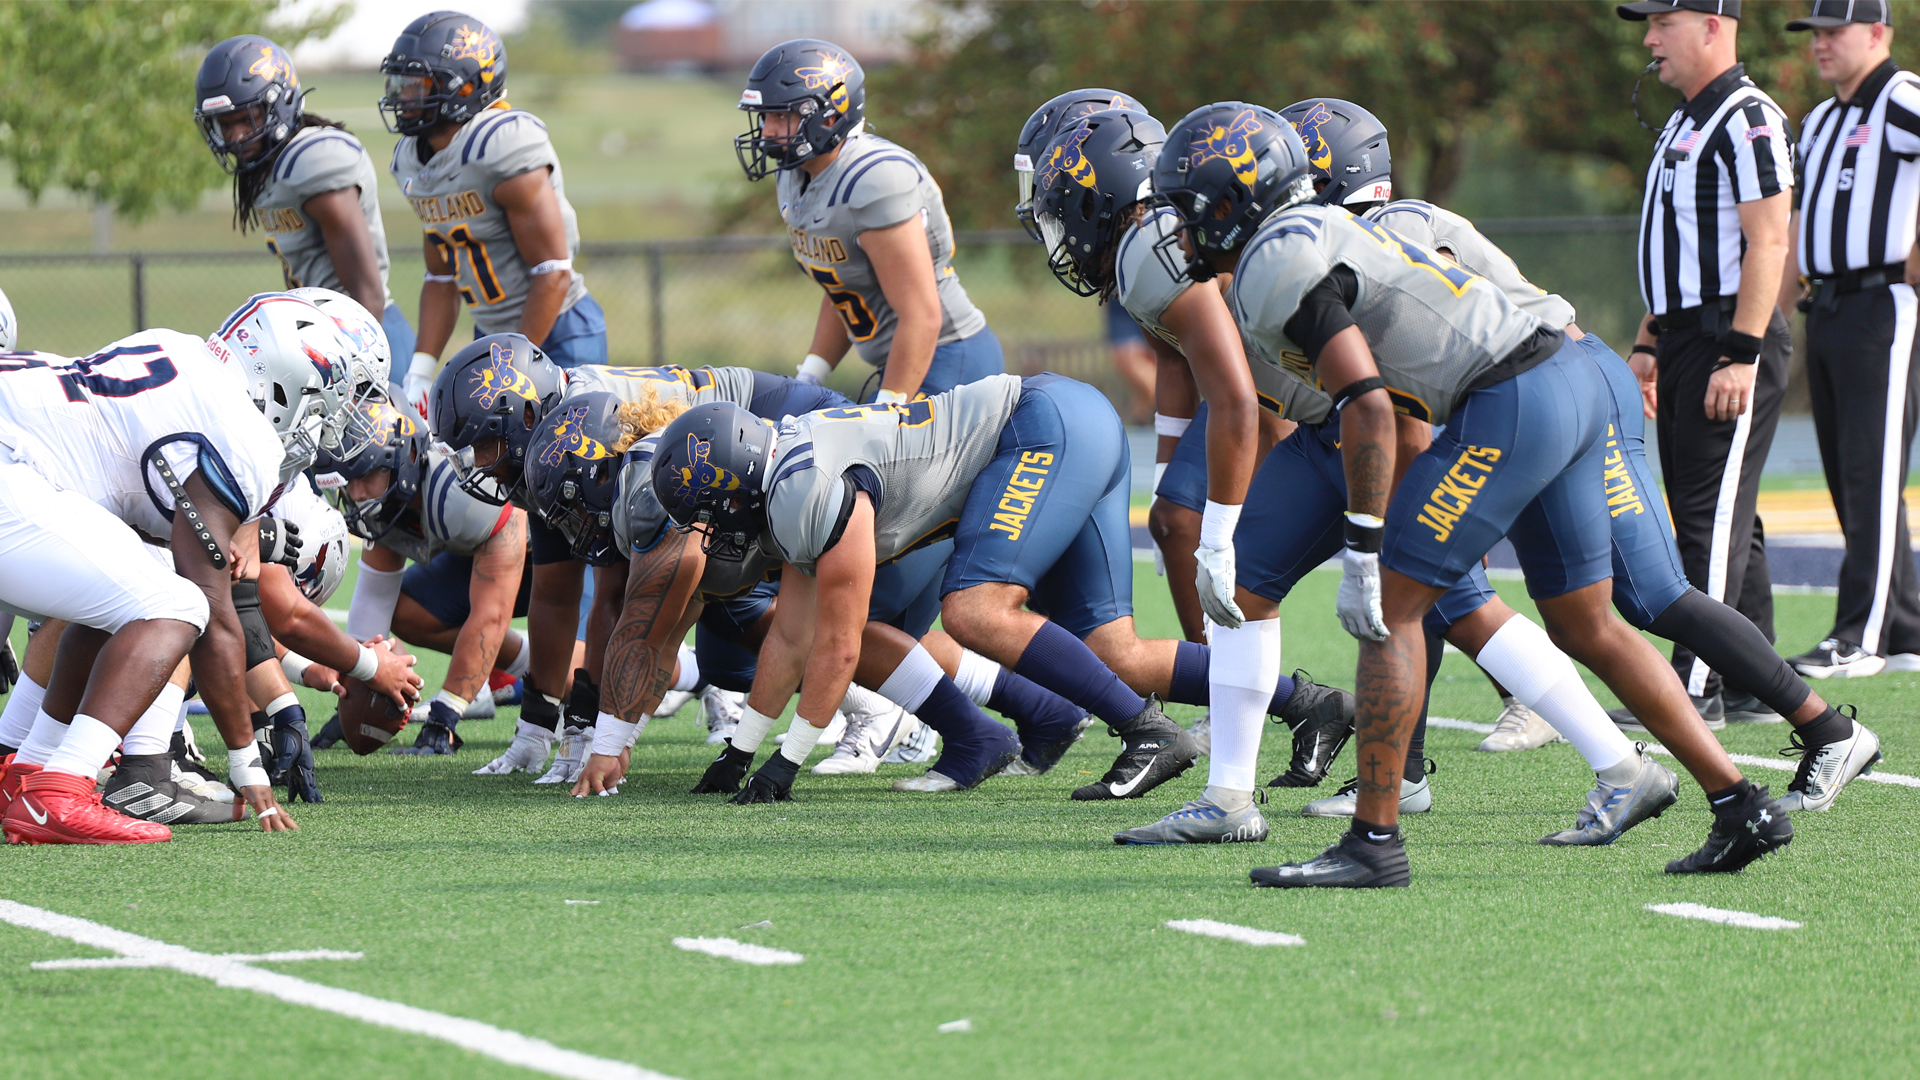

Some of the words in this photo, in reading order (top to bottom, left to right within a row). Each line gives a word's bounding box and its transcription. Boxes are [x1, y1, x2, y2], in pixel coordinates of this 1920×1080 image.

[408, 190, 486, 224] ACELAND
[1373, 185, 1392, 198] Rid
[1663, 167, 1675, 192] U
[1838, 167, 1855, 191] S
[424, 223, 506, 308] 21
[794, 255, 878, 341] 5
[206, 337, 231, 364] ddell
[989, 450, 1054, 541] JACKETS
[1416, 444, 1502, 542] JACKETS
[1603, 423, 1645, 518] JACKE
